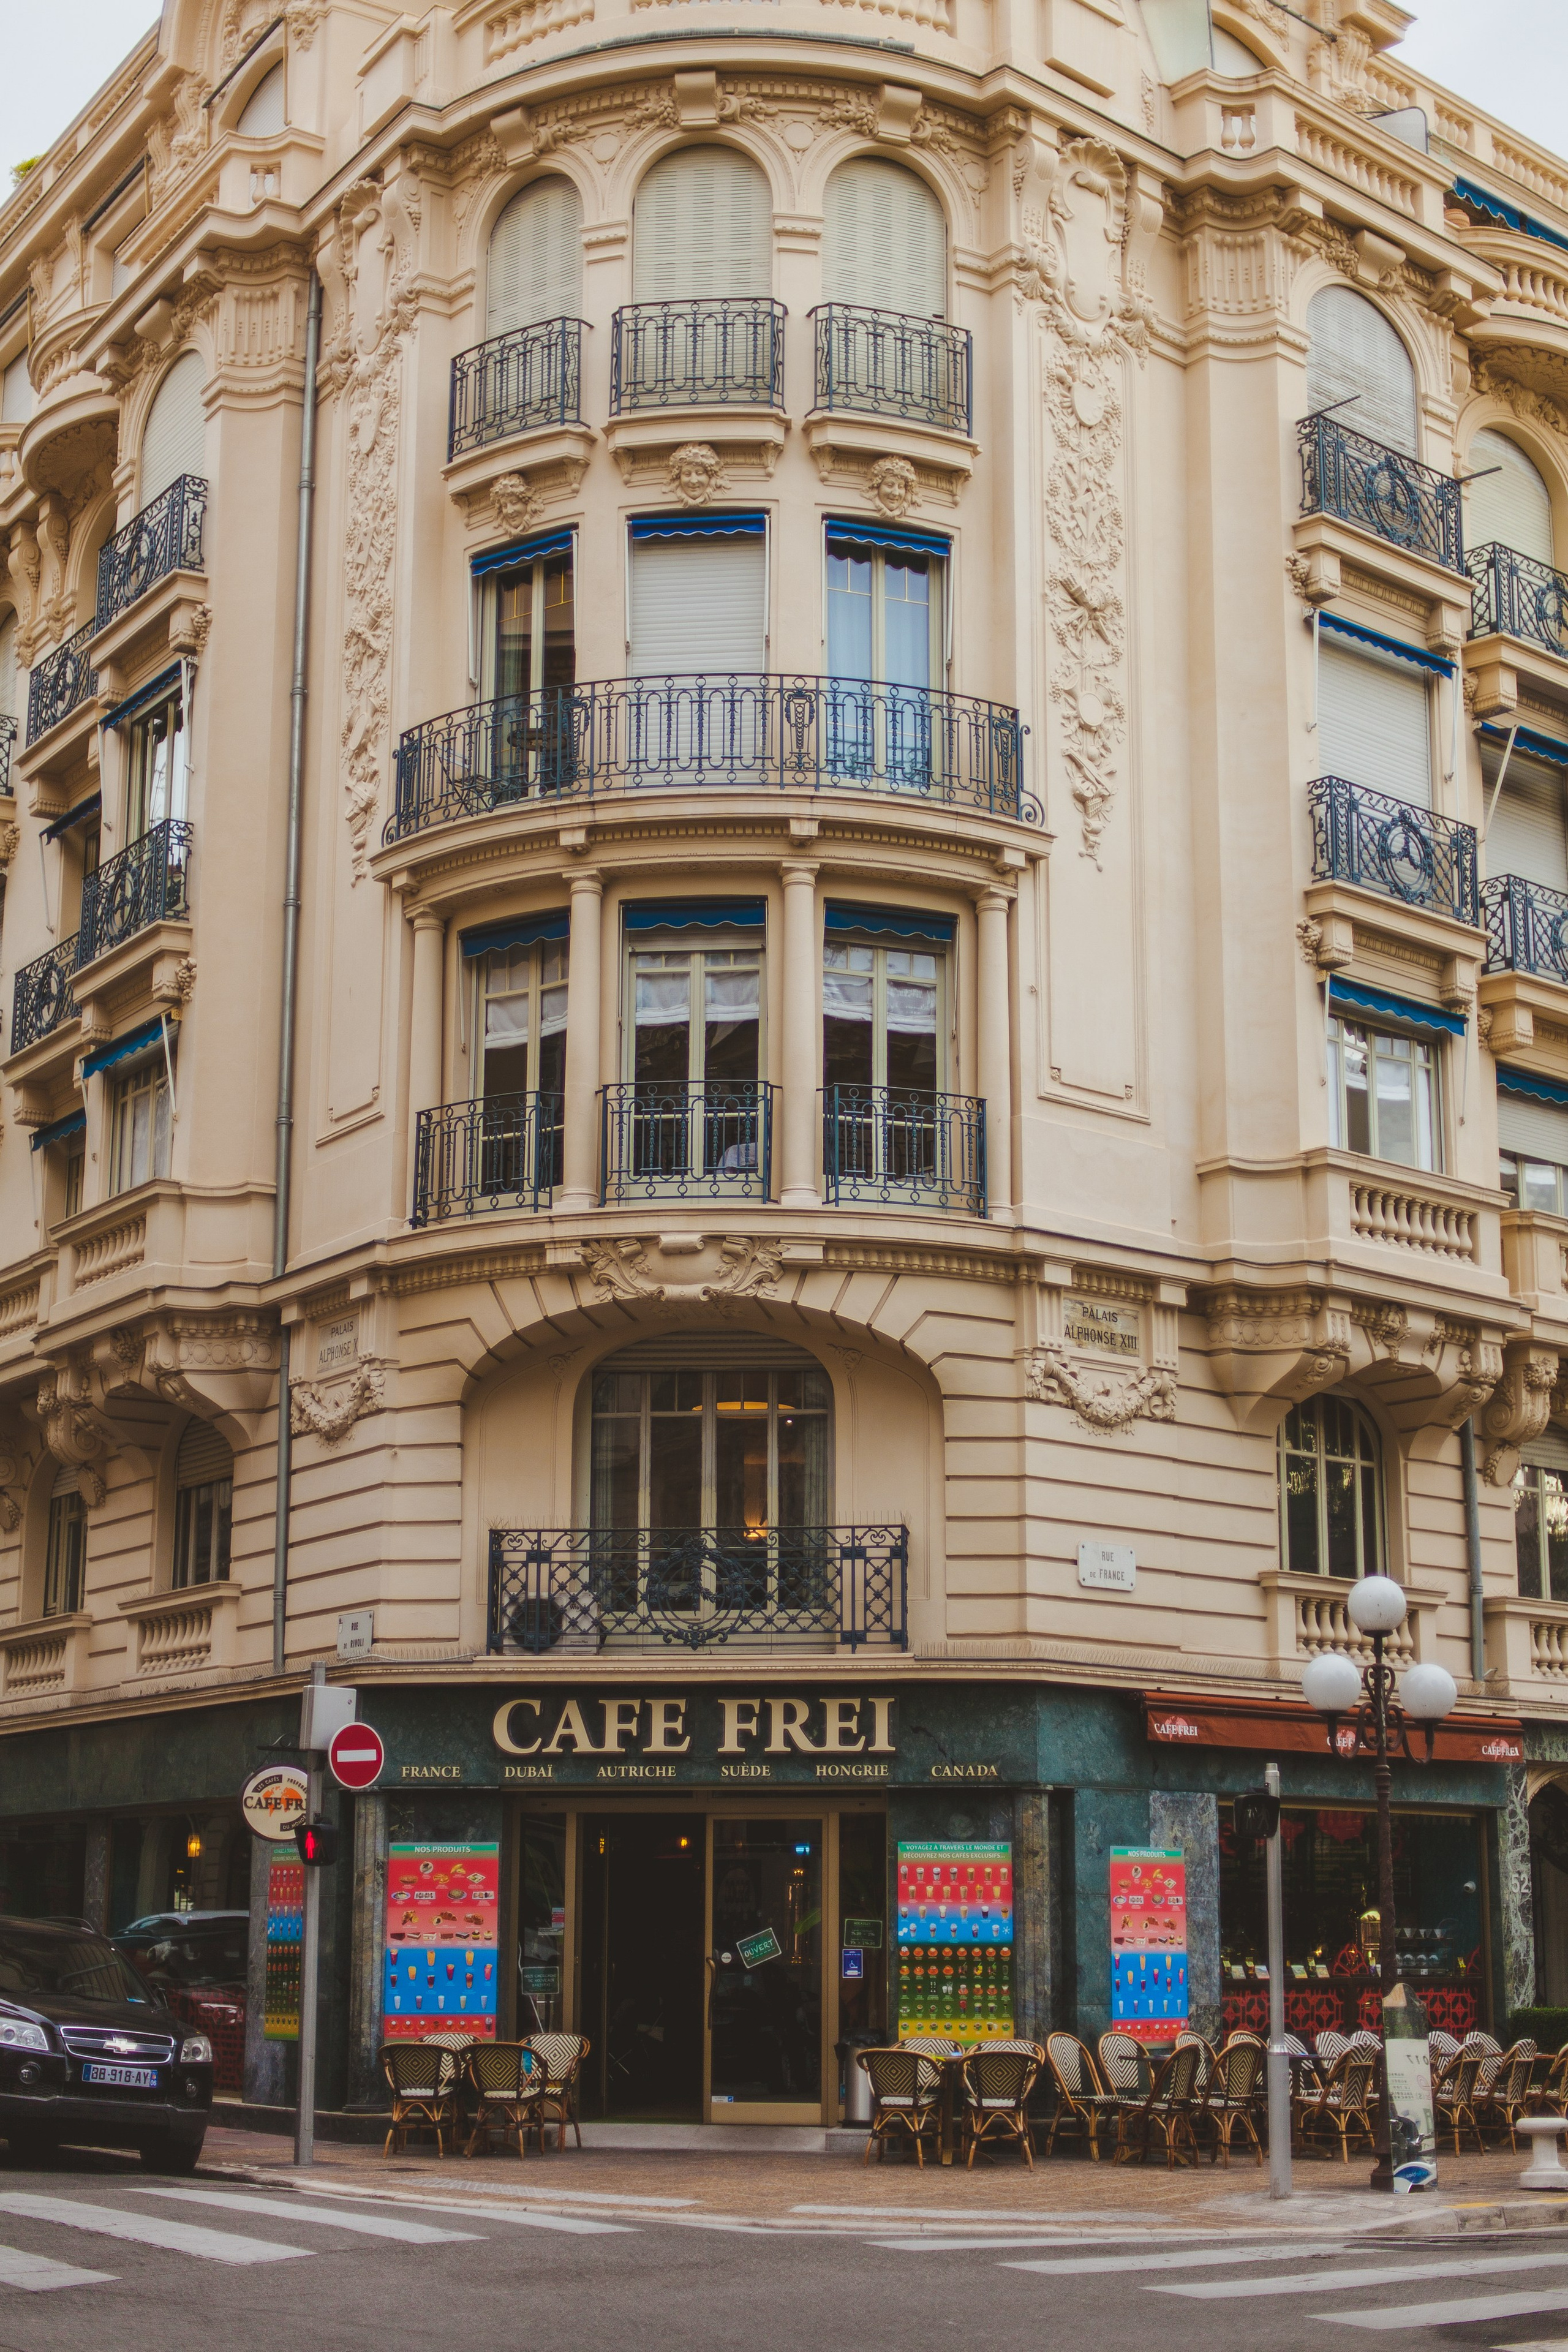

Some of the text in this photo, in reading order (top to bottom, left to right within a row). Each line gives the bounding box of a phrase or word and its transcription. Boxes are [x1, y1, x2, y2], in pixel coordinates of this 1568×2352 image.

[1082, 1306, 1118, 1322] PALAIS
[331, 1321, 353, 1338] PALAIS
[1065, 1324, 1137, 1349] ALPHONSE XIII
[318, 1341, 351, 1365] ALPHONSE
[1101, 1551, 1114, 1562] RUE
[1099, 1569, 1125, 1581] FRANCE
[350, 1638, 364, 1648] RIVOLI
[493, 1697, 896, 1753] CAFE FREI
[1154, 1723, 1198, 1736] CAFE FREI
[1482, 1745, 1520, 1756] CAFE FREI
[401, 1762, 998, 1777] FRANCE DUBAÏ AUTRICHE SUÈDE HONGRIE CANADA
[244, 1796, 306, 1810] CAFE FR
[1512, 1874, 1529, 1893] 52
[744, 1939, 773, 1957] OUVERT
